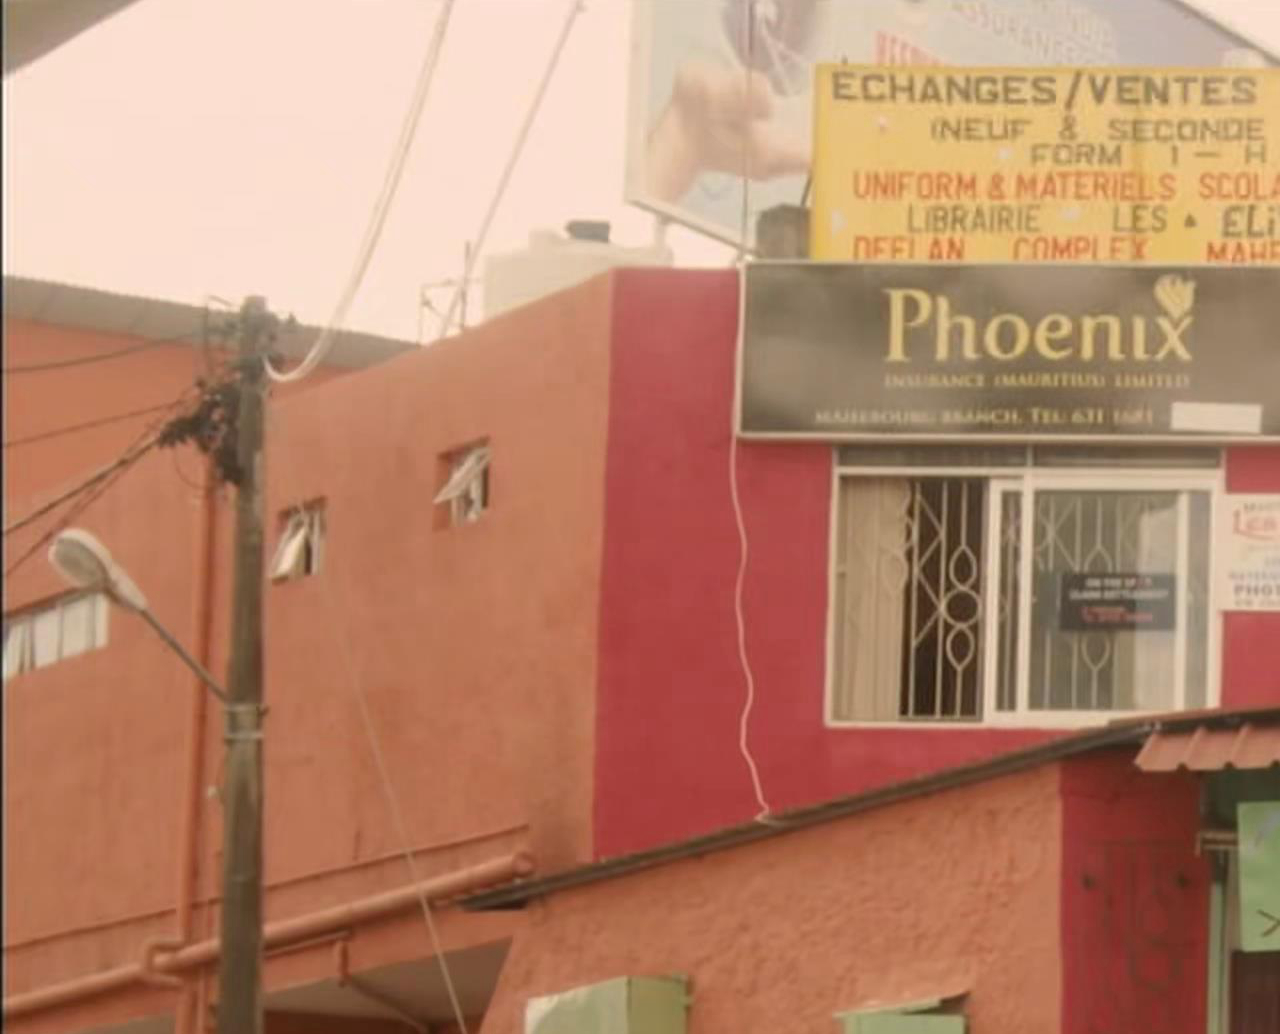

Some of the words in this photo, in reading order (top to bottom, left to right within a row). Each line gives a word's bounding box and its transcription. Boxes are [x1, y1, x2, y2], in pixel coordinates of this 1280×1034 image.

[1058, 115, 1078, 141] &
[1108, 118, 1264, 143] SECONDE
[1030, 143, 1122, 167] FORM
[853, 171, 977, 201] UNIFORM
[987, 173, 1008, 201] &
[1015, 171, 1177, 202] MATERIELS
[1112, 203, 1167, 234] LES
[883, 285, 1195, 363] Phoenix
